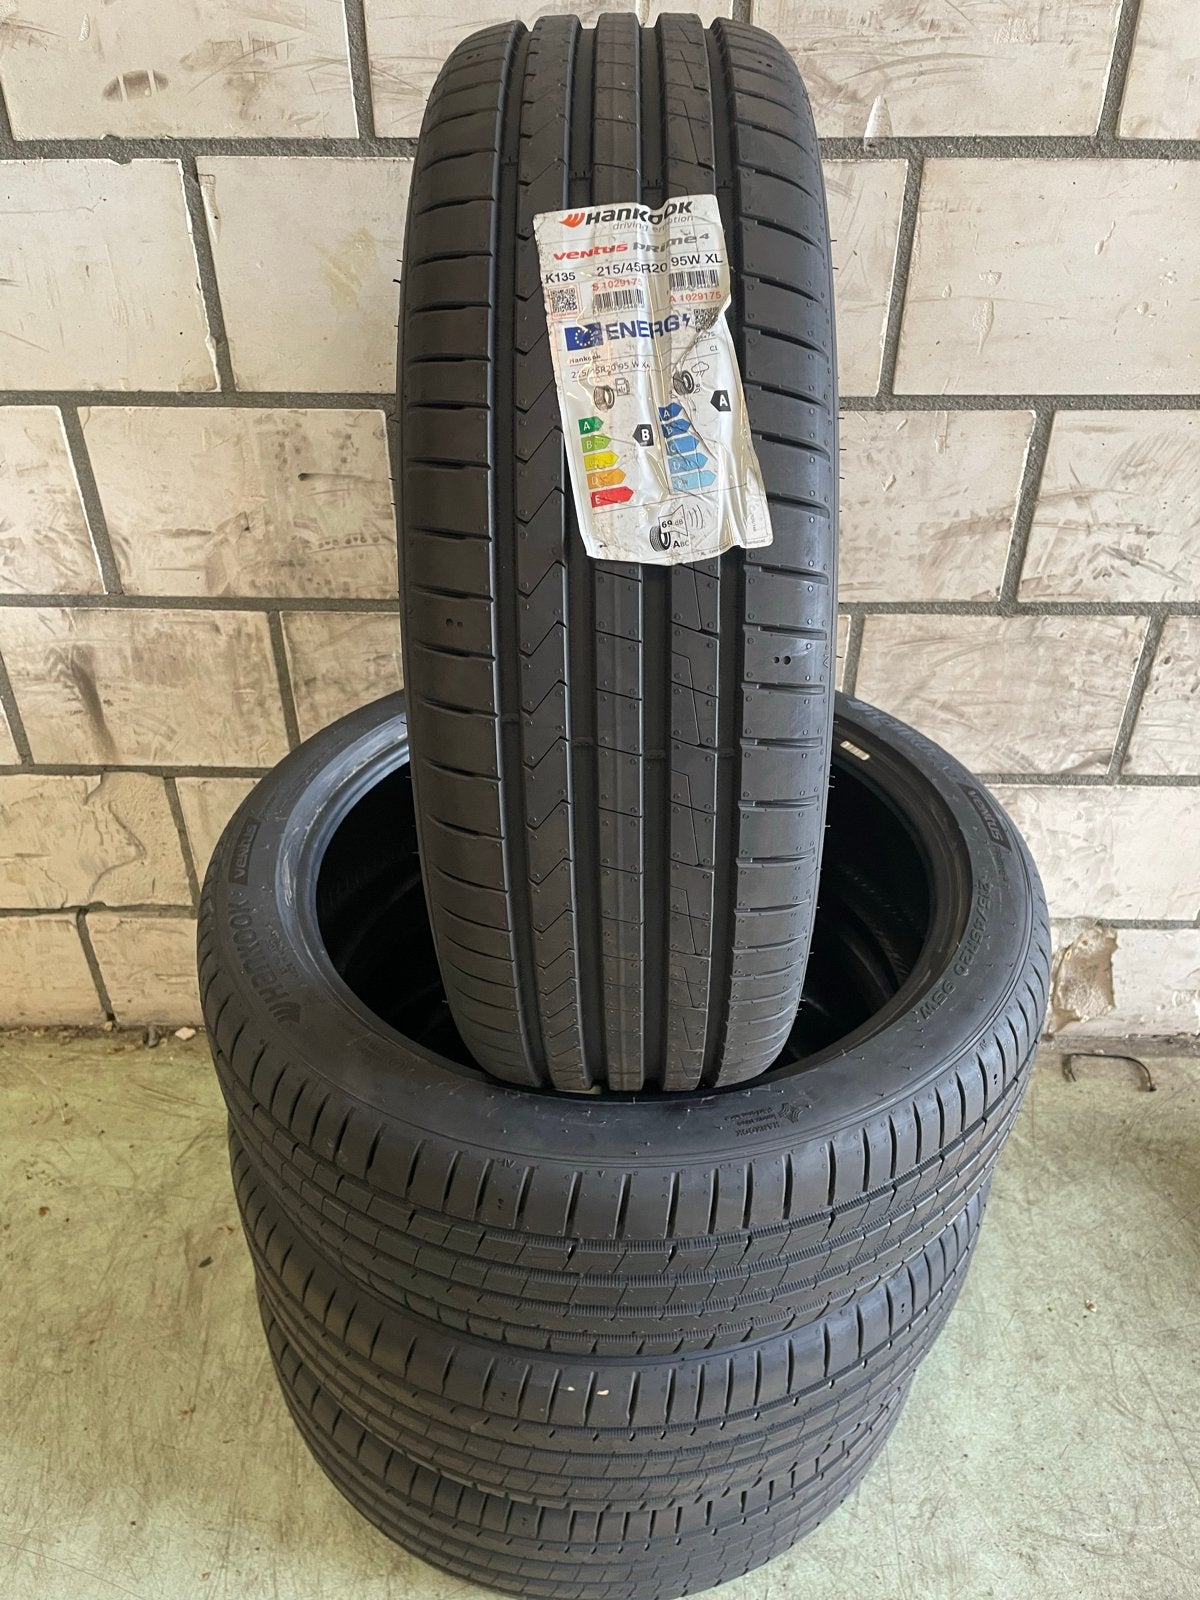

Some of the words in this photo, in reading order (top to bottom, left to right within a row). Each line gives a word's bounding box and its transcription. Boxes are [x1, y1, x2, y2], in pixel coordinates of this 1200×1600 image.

[613, 220, 649, 232] driving
[545, 272, 576, 284] K135
[596, 262, 668, 277] 215/45R20
[671, 254, 701, 267] 95W
[704, 253, 723, 264] XL
[669, 295, 676, 303] A
[680, 291, 722, 302] 1029175
[719, 394, 728, 407] A
[583, 421, 590, 431] A
[641, 428, 650, 441] B
[586, 441, 593, 450] B
[661, 519, 673, 529] 69
